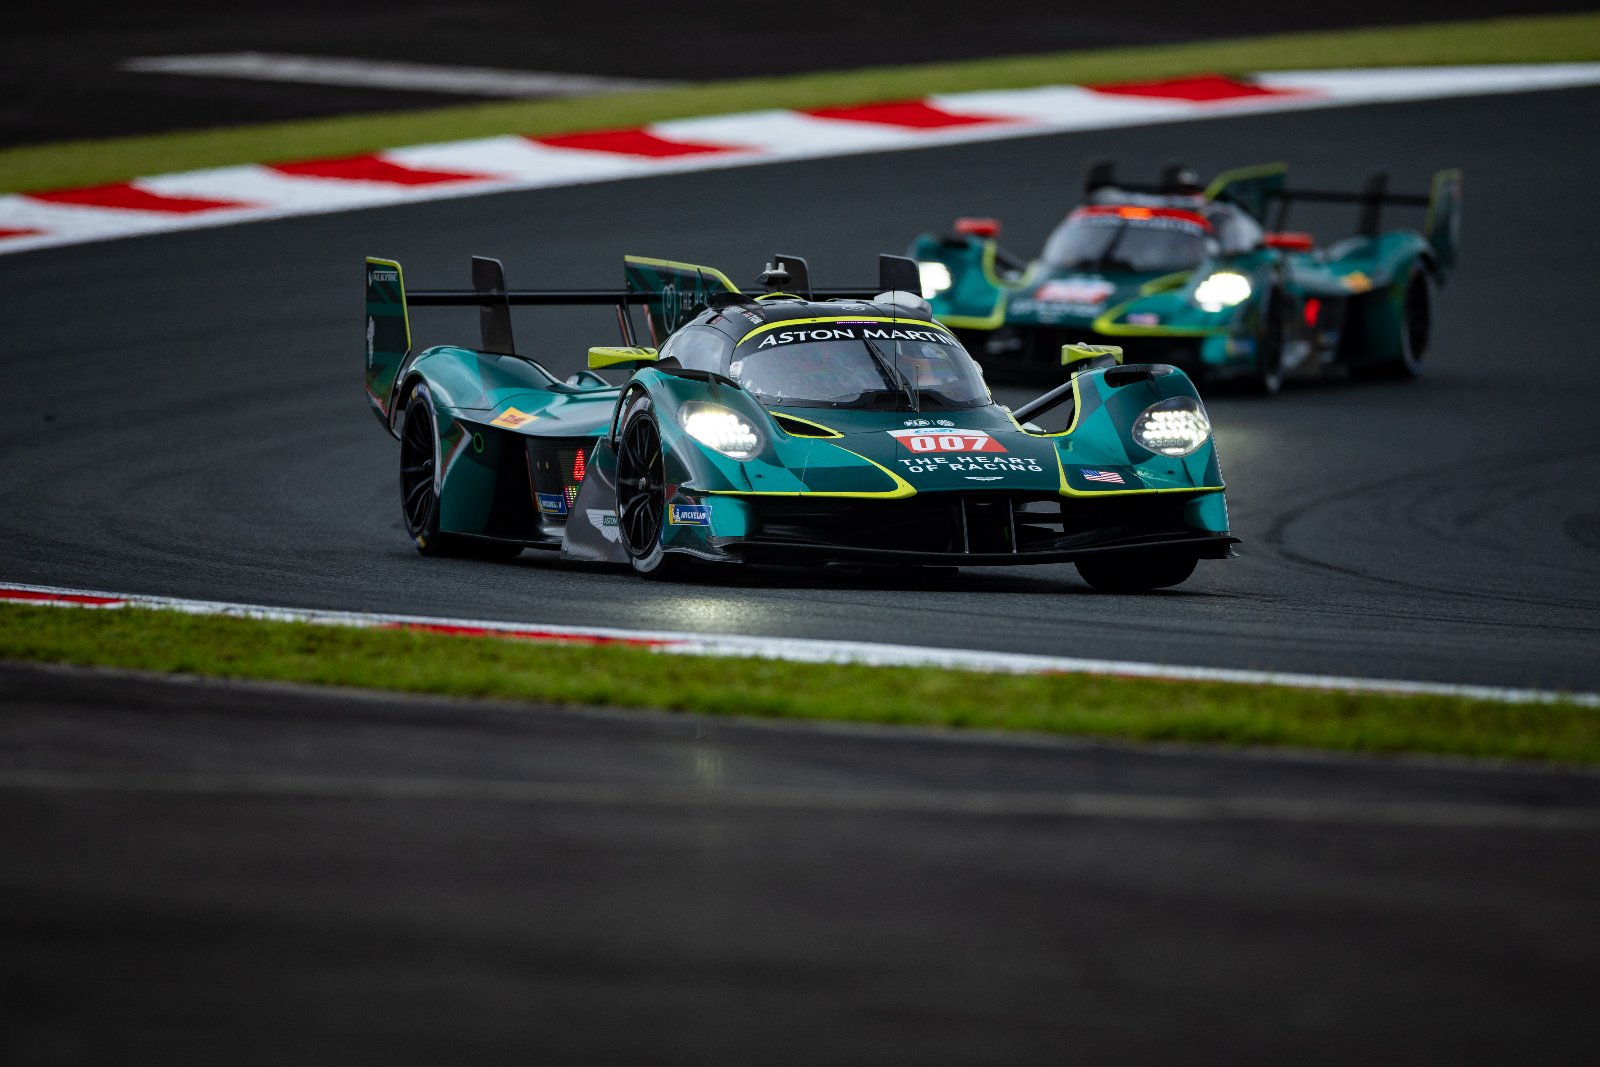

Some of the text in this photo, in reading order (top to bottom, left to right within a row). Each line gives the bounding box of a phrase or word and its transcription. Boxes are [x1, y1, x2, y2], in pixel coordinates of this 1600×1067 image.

[368, 271, 398, 287] VALKYRIE
[758, 328, 960, 349] ASTON MARTIN
[910, 435, 989, 451] 007
[898, 456, 1037, 466] THE HEART
[908, 463, 1043, 473] OF RACING
